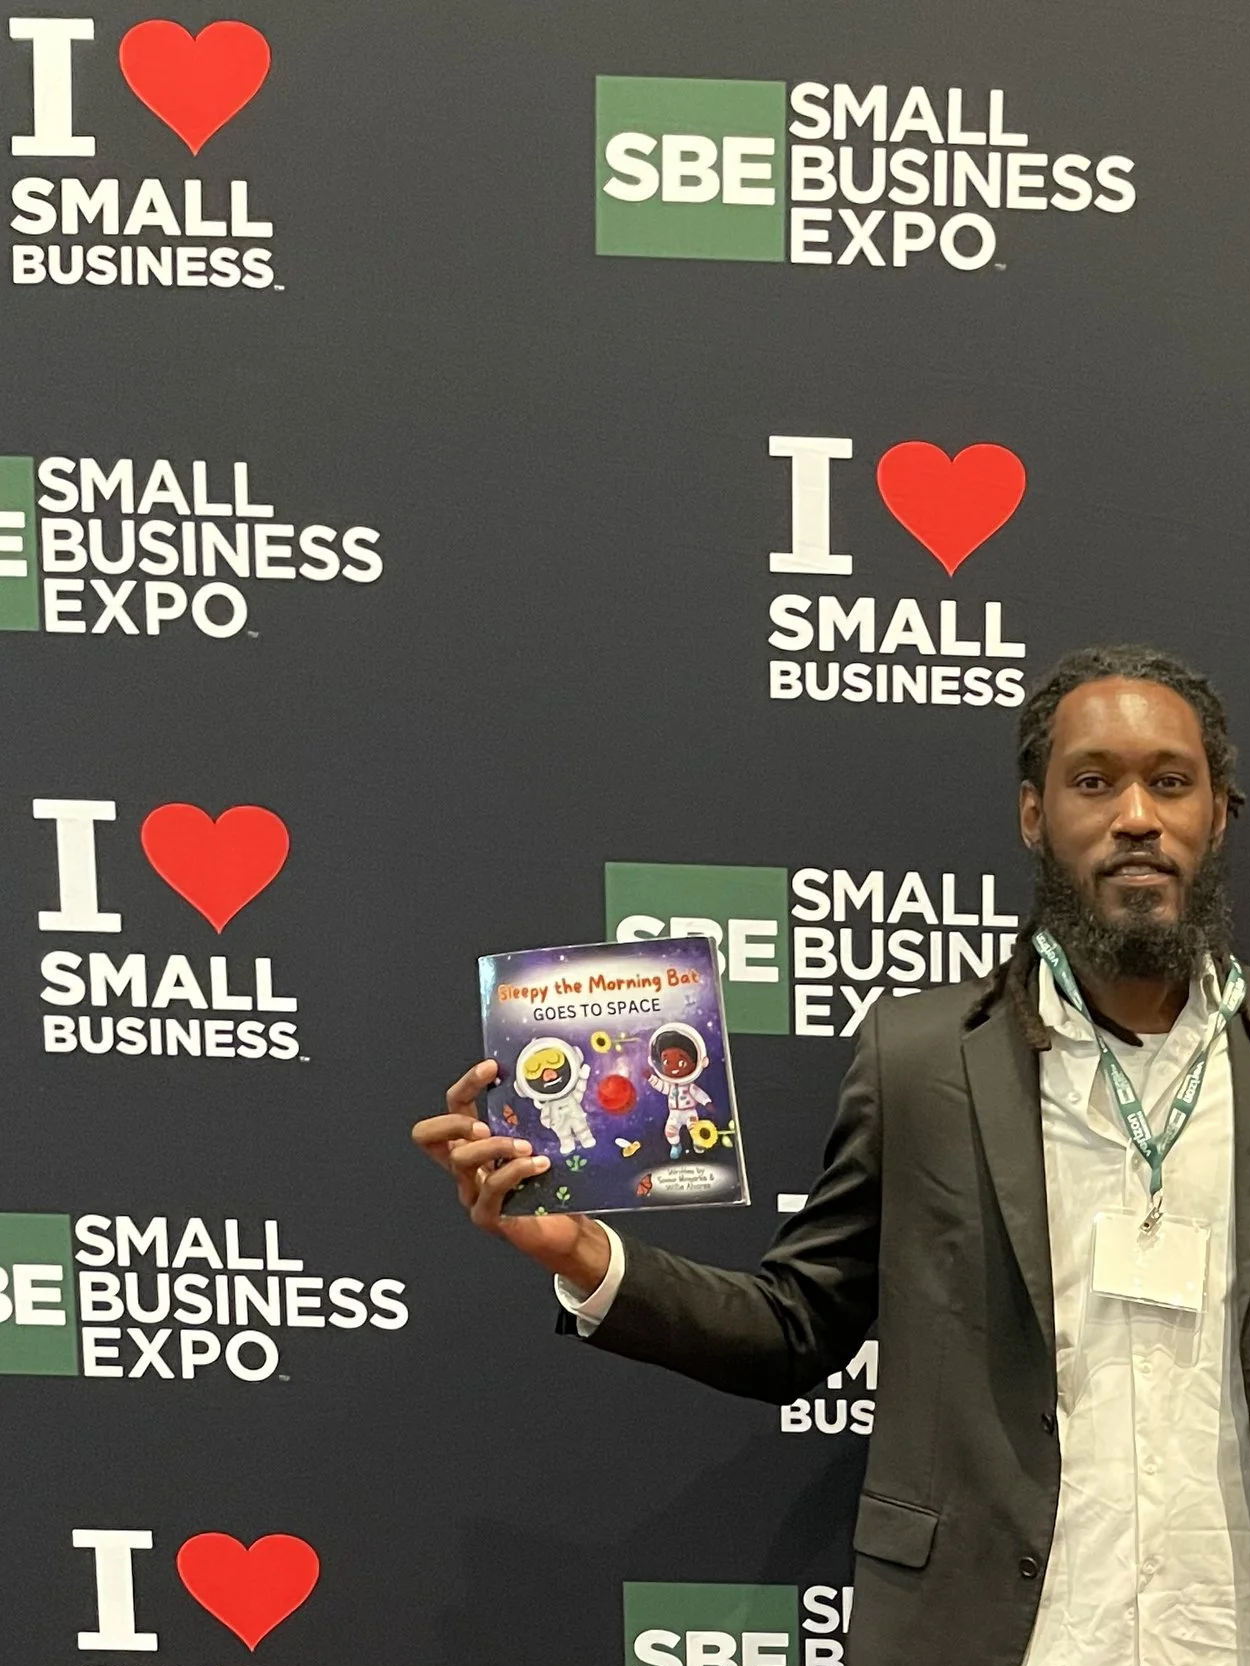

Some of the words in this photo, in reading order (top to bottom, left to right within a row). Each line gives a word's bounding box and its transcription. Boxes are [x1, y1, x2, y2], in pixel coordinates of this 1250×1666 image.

[9, 17, 95, 157] I
[789, 82, 1028, 147] SMALL
[603, 131, 776, 206] SBE
[791, 145, 1136, 213] BUSINESS
[10, 177, 273, 237] SMALL
[13, 245, 274, 288] BUSINESS
[791, 207, 996, 270] EXPO
[38, 457, 274, 517] SMALL
[769, 436, 852, 575] I
[42, 518, 383, 582] BUSINESS
[44, 578, 247, 638] EXPO
[768, 594, 1025, 658] SMALL
[770, 661, 1025, 707] BUSINESS
[33, 799, 121, 932] I
[792, 868, 1018, 927] SMALL
[40, 951, 297, 1012] SMALL
[794, 927, 1018, 983] BUSIN
[498, 980, 548, 1003] Sleepy
[554, 977, 582, 995] the
[588, 973, 662, 994] Morning
[667, 969, 700, 987] Bat
[533, 1004, 576, 1022] GOES
[580, 1003, 602, 1018] TO
[606, 998, 661, 1015] SPACE
[795, 985, 921, 1037] EX
[43, 1015, 299, 1059] BUSINESS
[1127, 1113, 1152, 1157] verizon
[75, 1215, 303, 1271] SMALL
[79, 1271, 408, 1329] BUSINESS
[82, 1327, 278, 1381] EXPO
[72, 1529, 157, 1651] I
